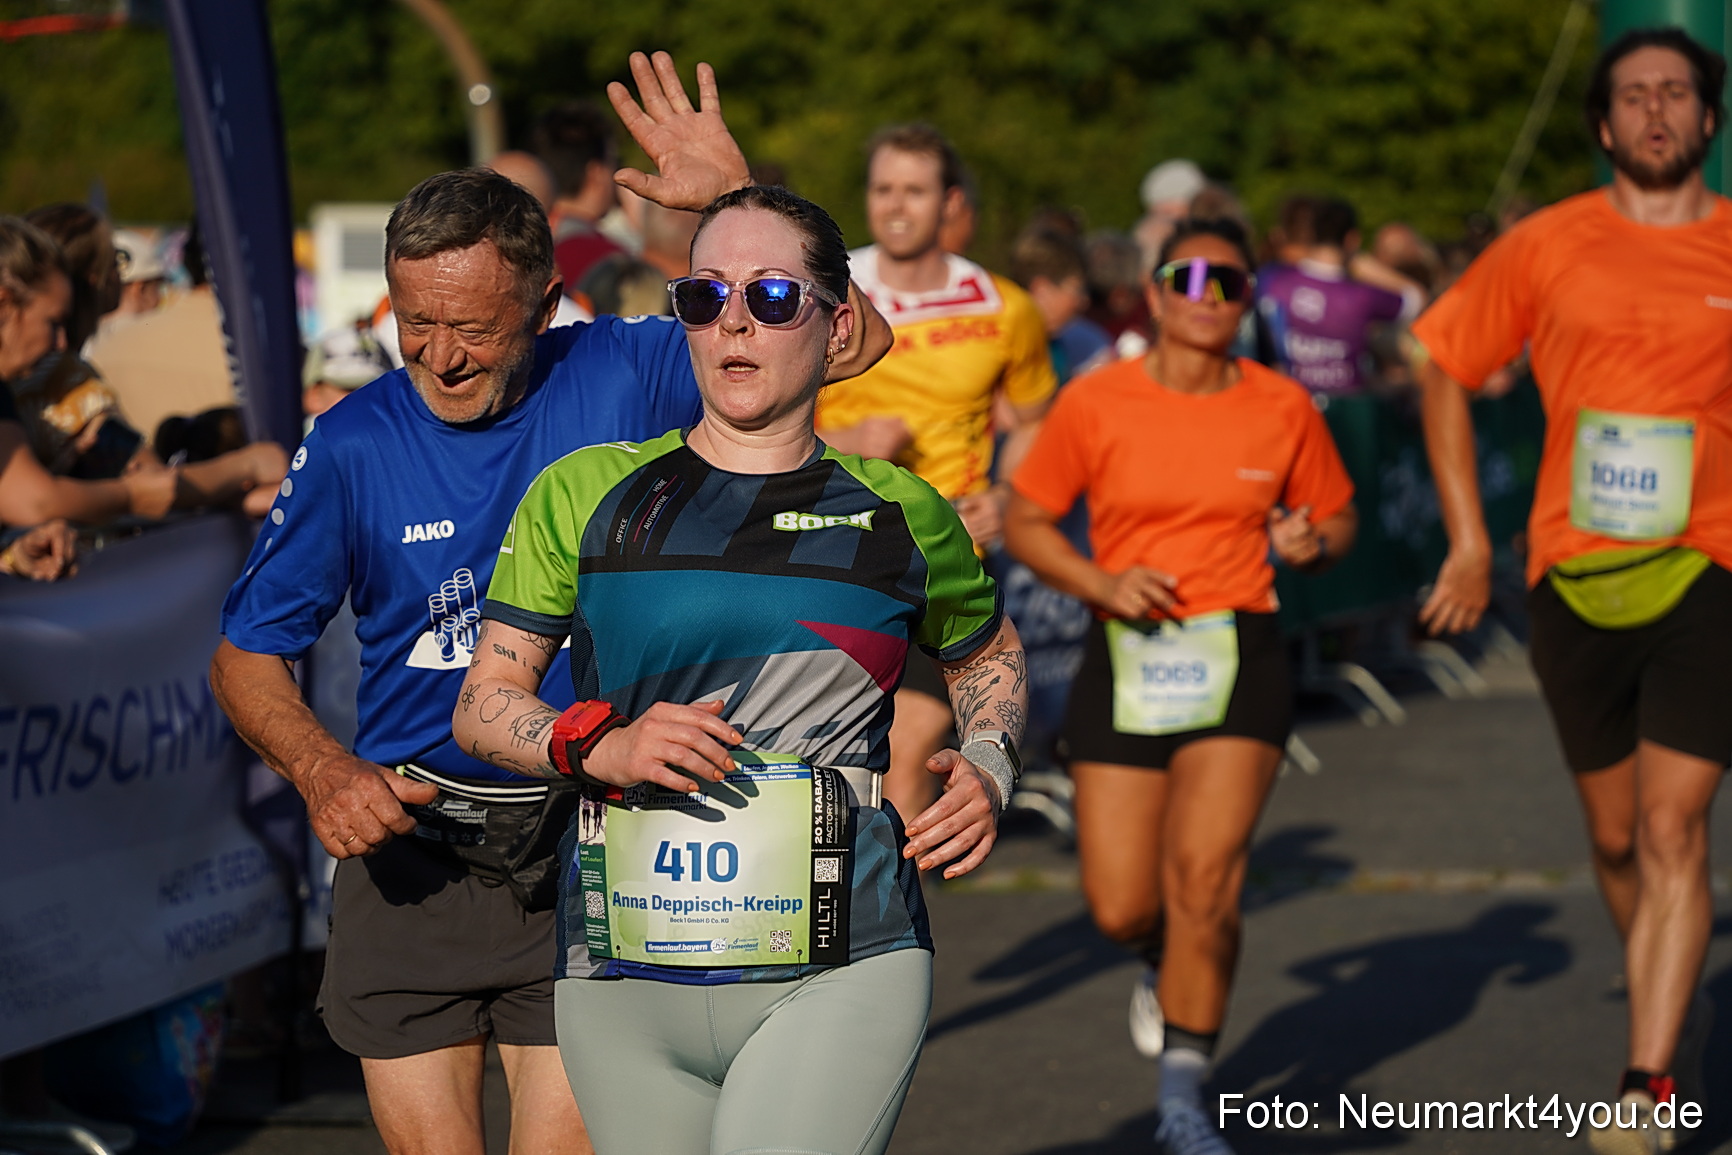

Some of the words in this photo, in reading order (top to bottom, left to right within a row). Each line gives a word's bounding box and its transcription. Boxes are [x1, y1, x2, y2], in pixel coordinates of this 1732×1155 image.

[652, 478, 668, 493] HOME
[1589, 460, 1658, 495] 1068
[643, 494, 669, 531] AUTOMOTIVE
[774, 510, 875, 531] BOCK
[401, 519, 455, 544] JAKO
[615, 517, 628, 544] OFFICE
[1140, 660, 1208, 685] 1069
[648, 791, 709, 804] Firmenlauf
[813, 766, 823, 814] RABATT
[823, 769, 833, 801] OUTLET
[669, 802, 707, 811] neumarkt
[814, 815, 823, 825] %
[814, 826, 823, 845] 20
[654, 840, 739, 883] 410
[612, 891, 648, 910] Anna
[651, 894, 803, 916] Deppisch-Kreipp
[817, 888, 830, 948] HILTL
[647, 943, 708, 952] firmenlauf.bayern
[727, 942, 759, 950] Firmenlauf
